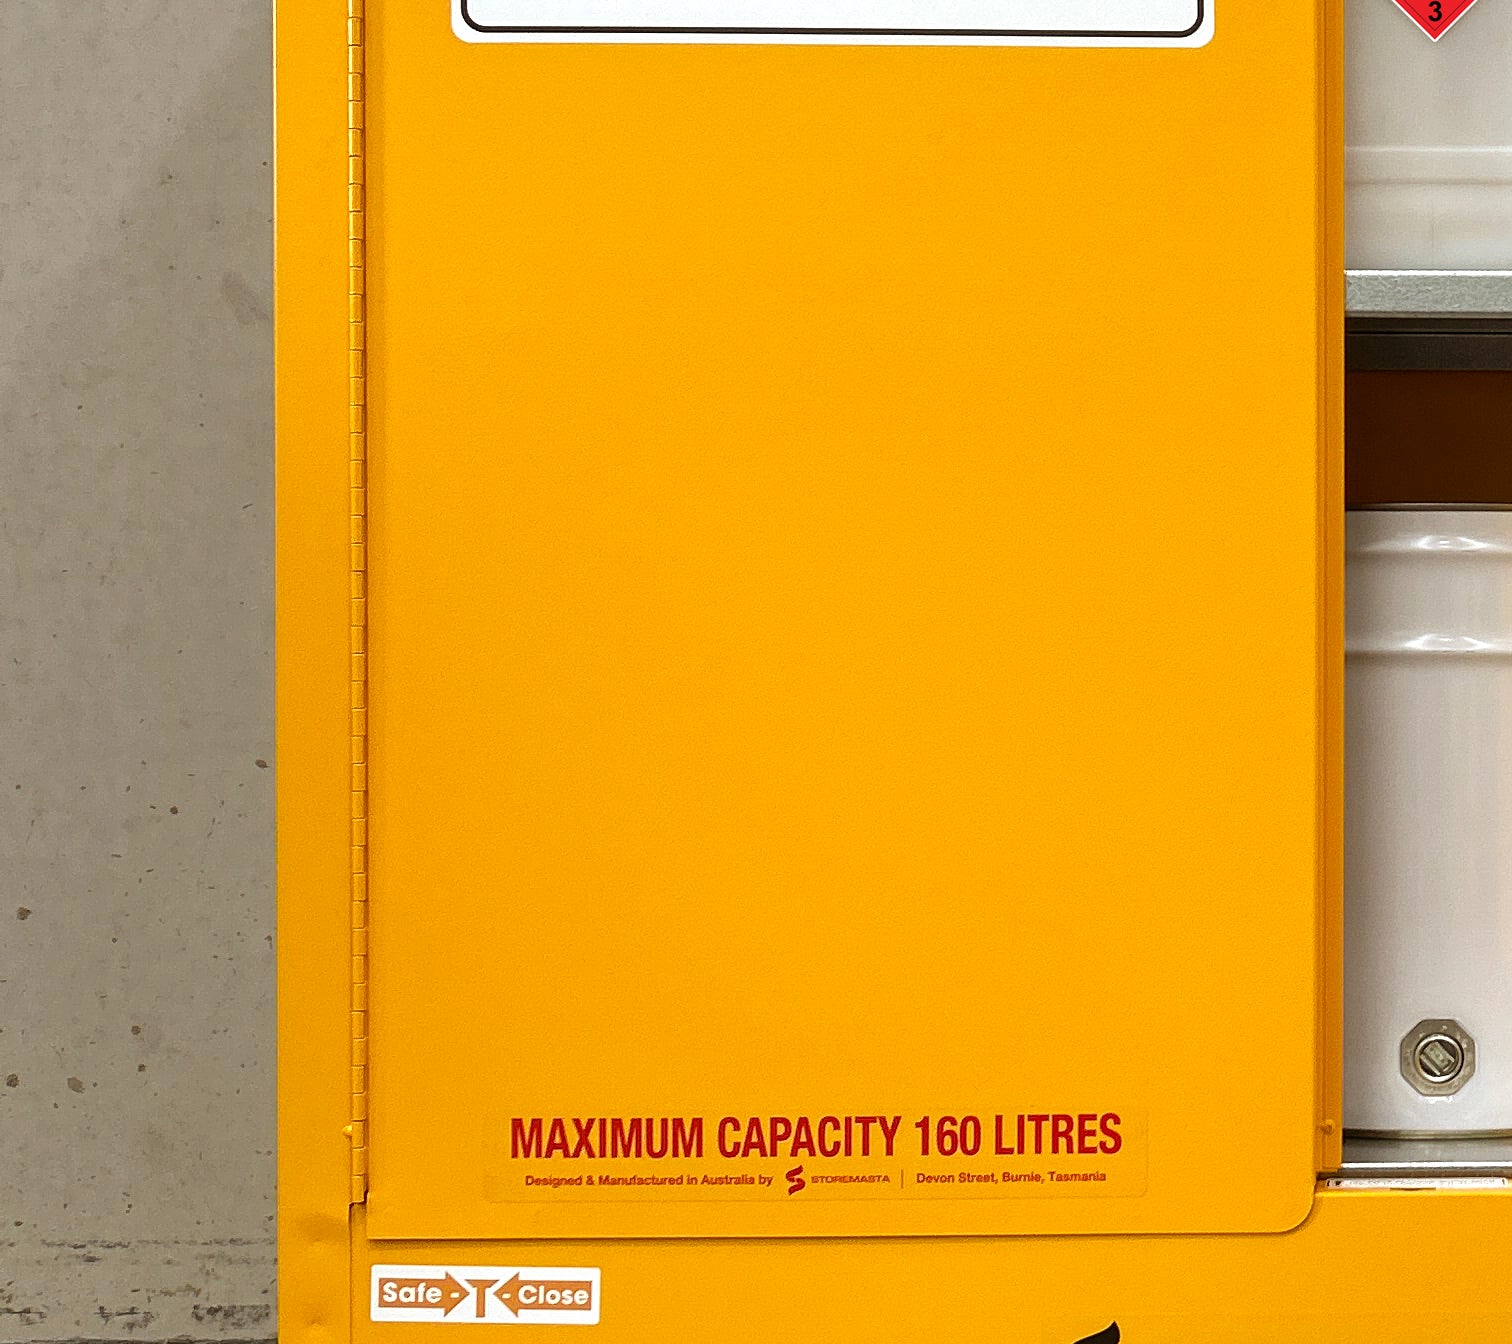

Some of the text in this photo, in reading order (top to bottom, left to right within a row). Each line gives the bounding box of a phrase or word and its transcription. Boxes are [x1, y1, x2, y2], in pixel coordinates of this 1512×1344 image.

[1428, 0, 1443, 22] 3
[510, 1112, 1123, 1159] MAXIMUM CAPACITY 160 LITRES
[525, 1174, 774, 1188] Designed & Manufactured in Australia by
[916, 1172, 956, 1184] Devon
[1047, 1170, 1107, 1183] Tasmania
